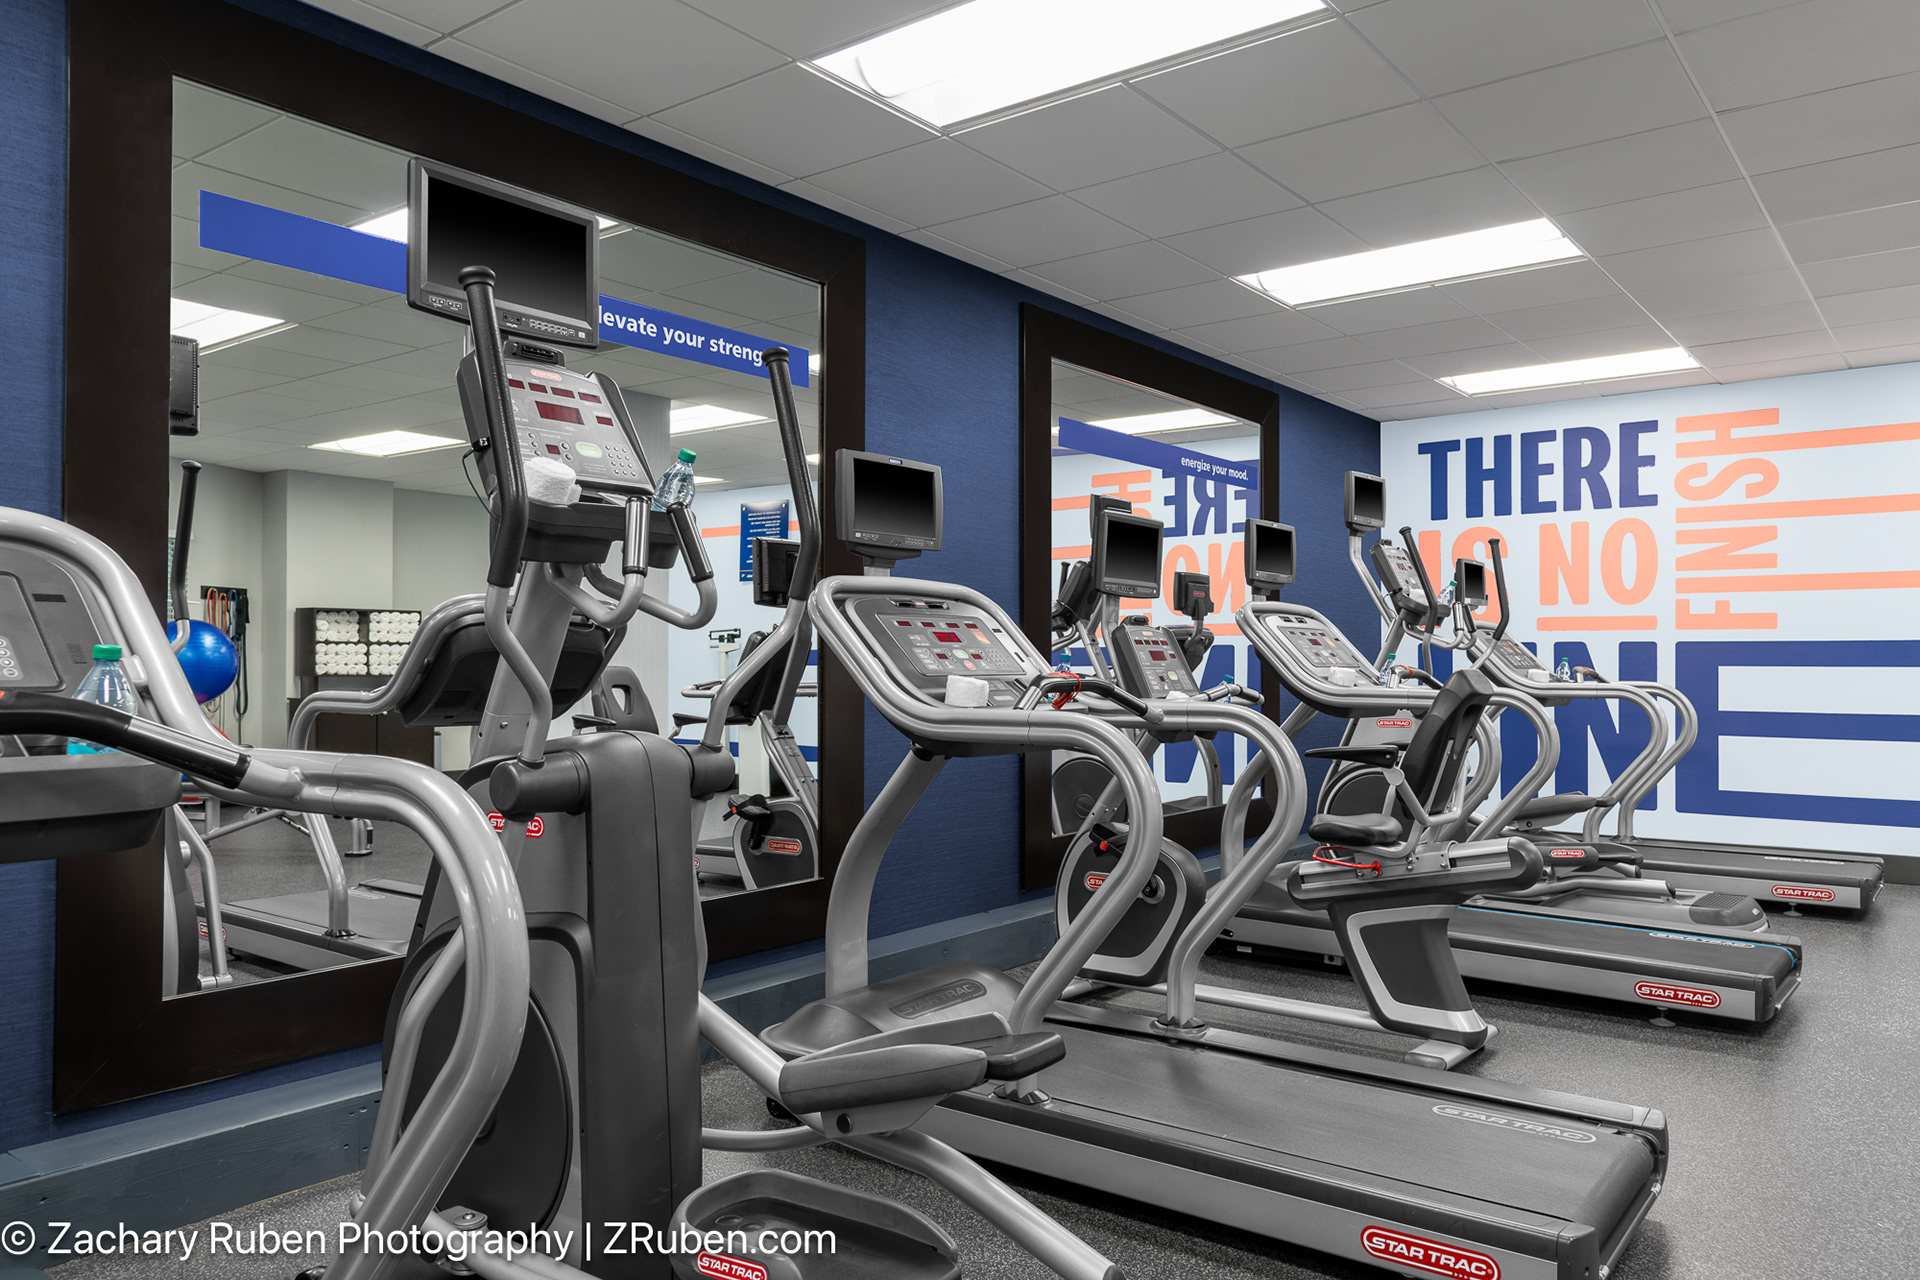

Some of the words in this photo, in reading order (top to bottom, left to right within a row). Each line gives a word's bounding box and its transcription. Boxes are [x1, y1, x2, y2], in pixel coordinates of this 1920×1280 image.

[599, 305, 658, 337] levate
[663, 326, 705, 348] your
[709, 338, 764, 367] streng
[1181, 457, 1210, 472] energize
[1212, 464, 1227, 476] your
[1228, 469, 1249, 481] mood.
[1418, 420, 1658, 520] THERE
[1674, 408, 1779, 630] FINISH
[1419, 526, 1509, 629] IS
[1539, 517, 1658, 606] NO
[490, 818, 505, 827] STA
[1776, 888, 1801, 896] STAR
[1802, 890, 1830, 898] TRAC
[900, 995, 939, 1015] STAR
[937, 984, 975, 1000] TRAC
[1641, 986, 1675, 998] STAR
[1676, 991, 1713, 1003] TRAC
[1442, 1108, 1508, 1124] STAR
[1512, 1121, 1585, 1139] TRAC
[701, 1256, 730, 1273] STAR
[731, 1265, 762, 1280] TRAC
[1372, 1236, 1425, 1260] STAR
[1427, 1250, 1488, 1276] TRAC
